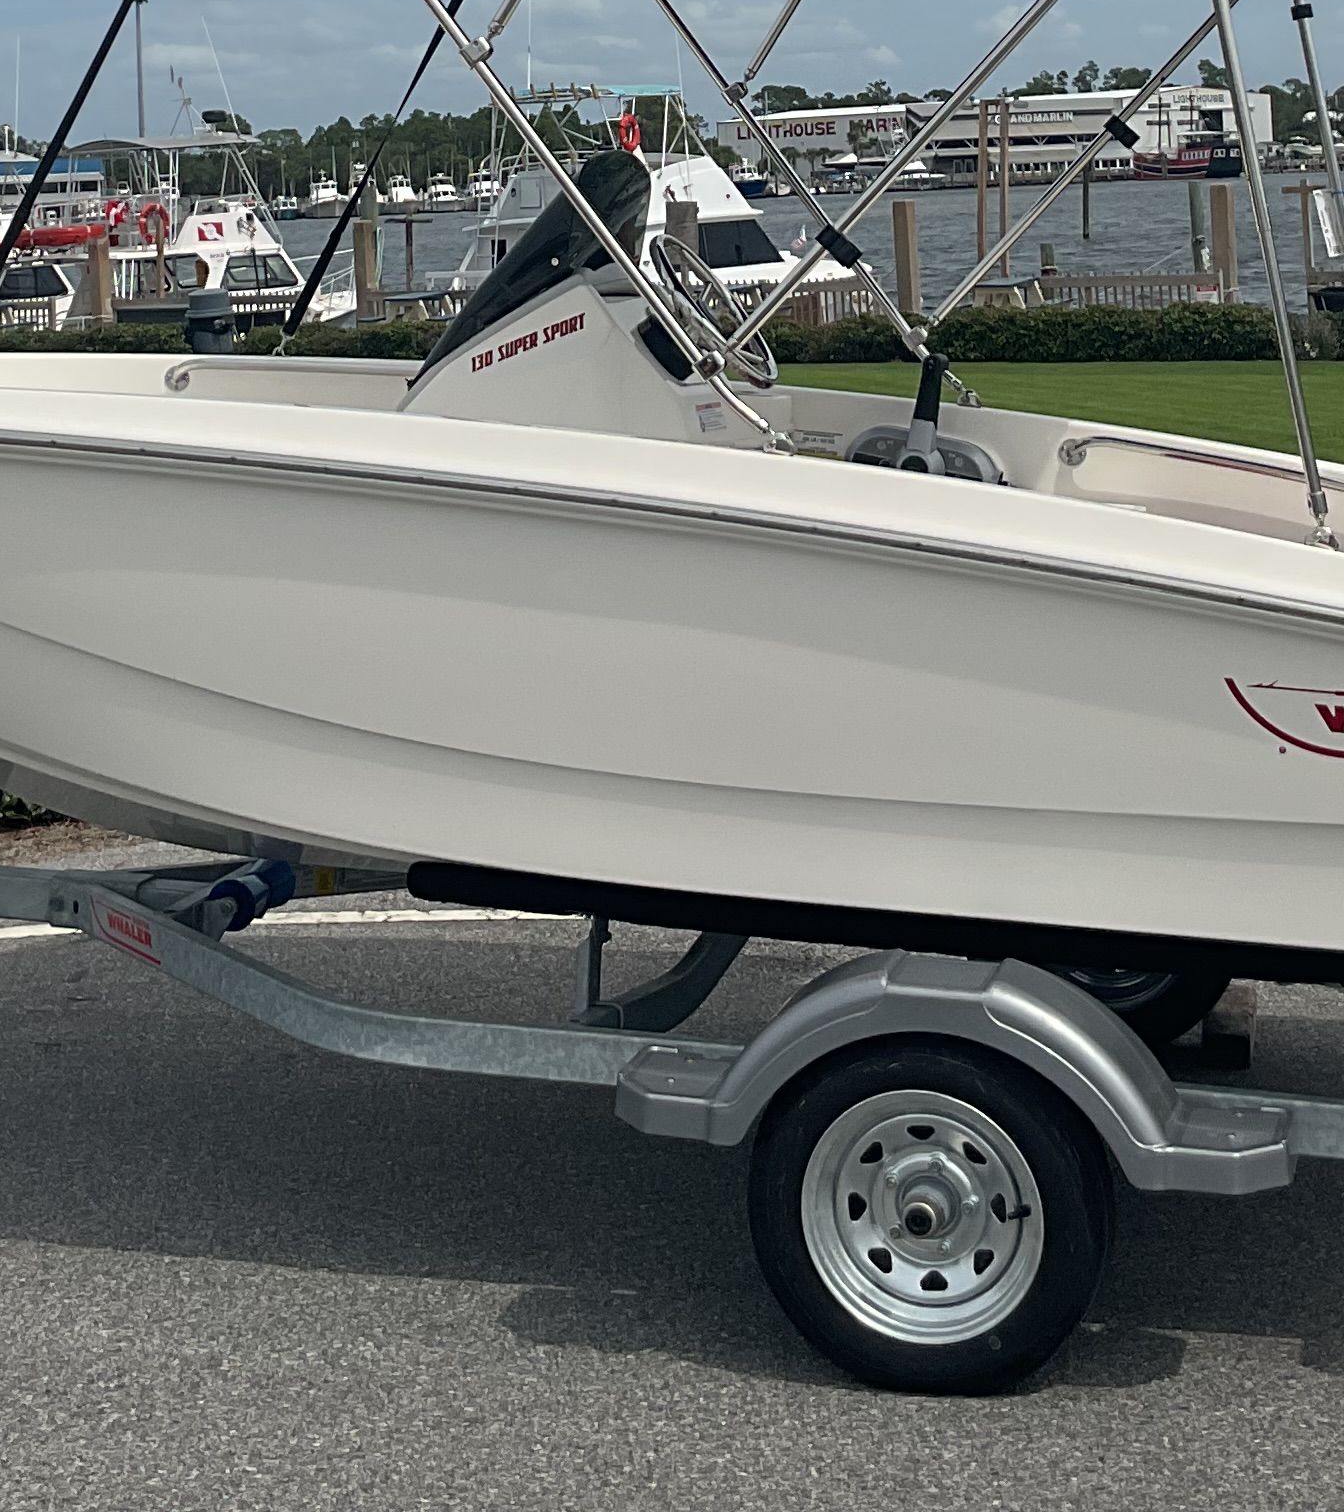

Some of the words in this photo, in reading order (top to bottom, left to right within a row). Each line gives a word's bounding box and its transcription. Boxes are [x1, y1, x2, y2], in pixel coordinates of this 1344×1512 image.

[737, 121, 836, 140] LITHOUSE
[994, 113, 1032, 124] GAND
[471, 350, 493, 373] 130
[497, 331, 538, 362] SUPER
[543, 312, 585, 344] SPORT
[107, 912, 152, 949] WHALER
